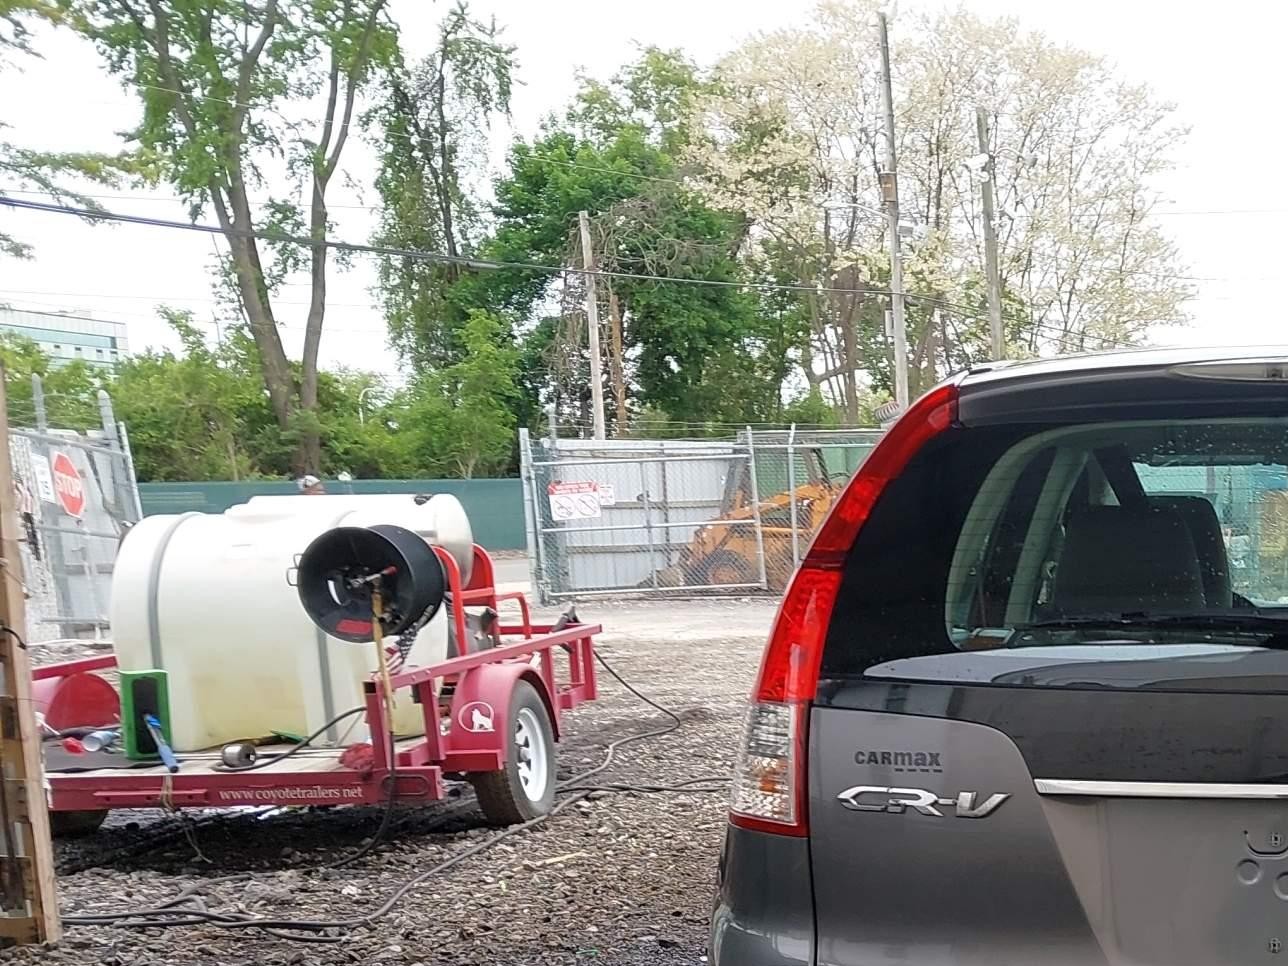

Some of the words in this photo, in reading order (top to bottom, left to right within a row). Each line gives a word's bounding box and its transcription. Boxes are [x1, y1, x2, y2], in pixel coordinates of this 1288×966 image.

[54, 472, 82, 500] STOP
[219, 785, 363, 801] wwwcoyotetrailersnet
[837, 785, 1012, 818] CR-V
